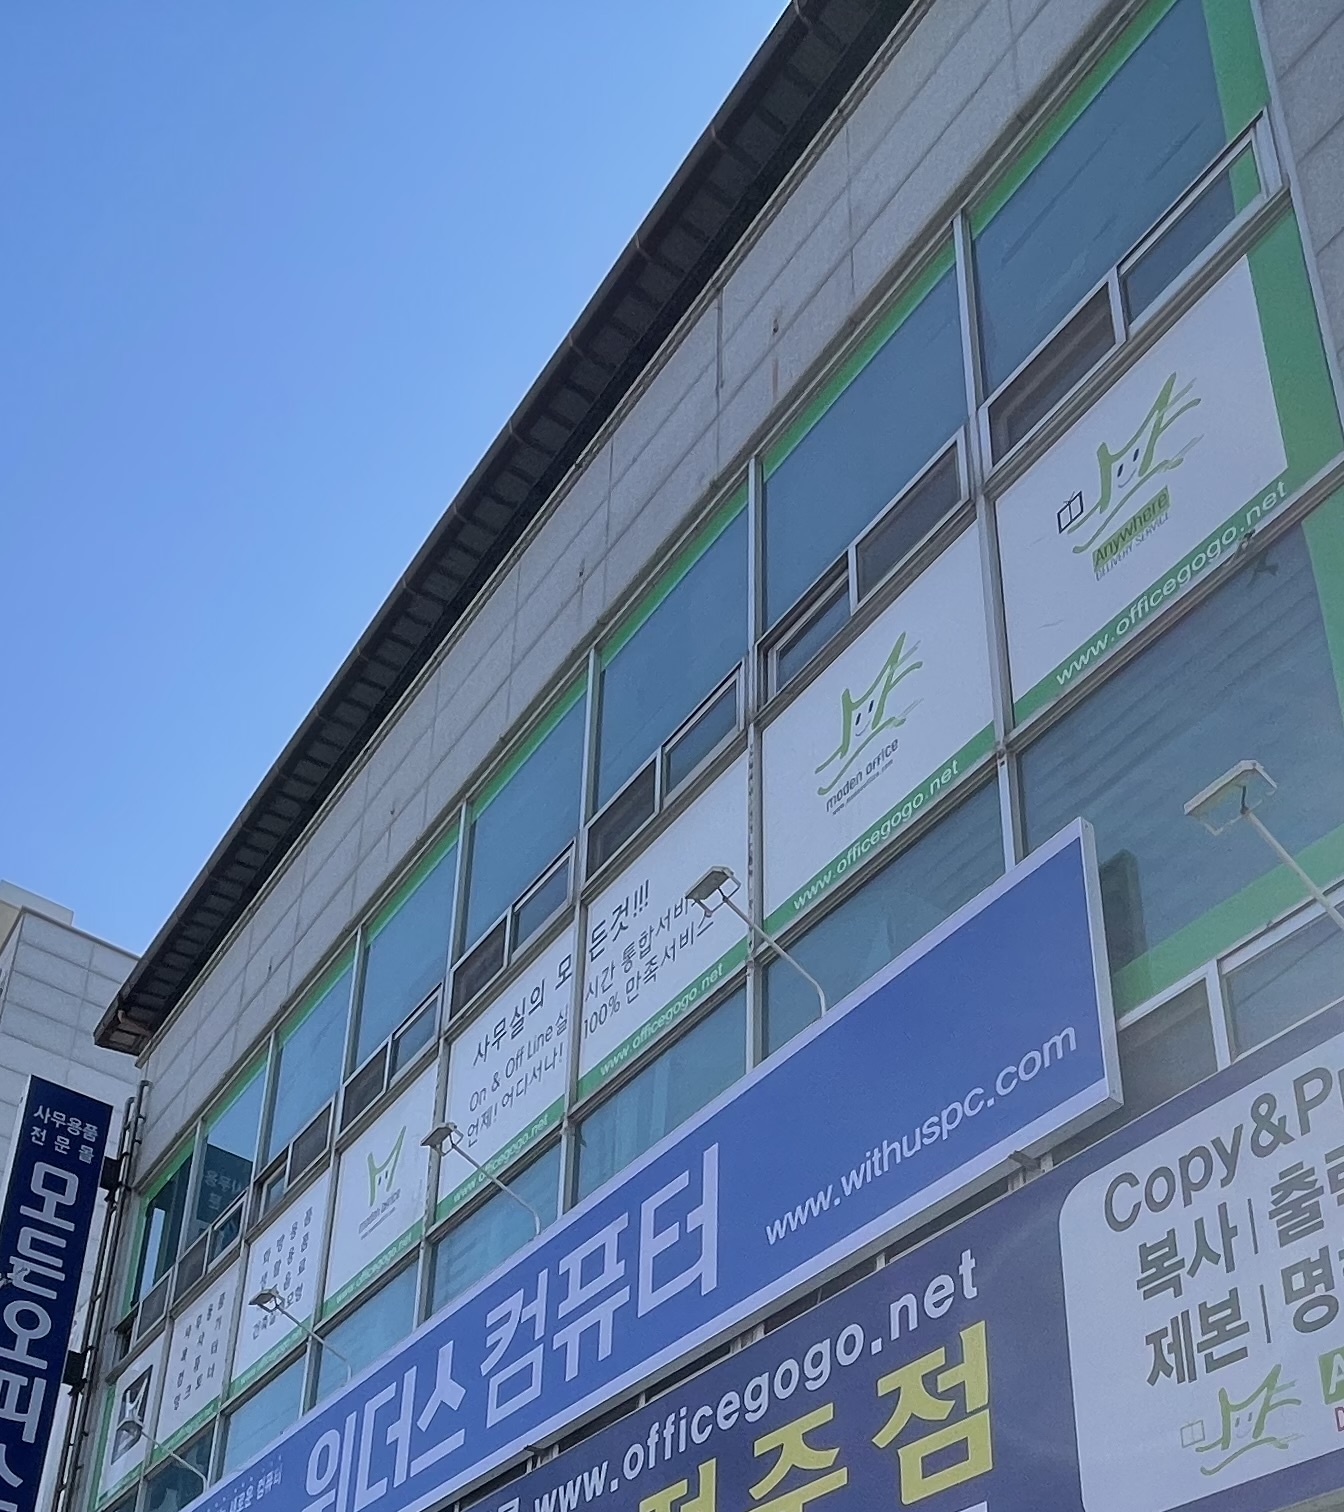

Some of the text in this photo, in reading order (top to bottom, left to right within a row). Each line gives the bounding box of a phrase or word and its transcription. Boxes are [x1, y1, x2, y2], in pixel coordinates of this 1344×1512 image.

[1095, 492, 1168, 567] Anywhere
[1055, 479, 1289, 688] www.officegogo.net
[825, 770, 863, 813] moden
[865, 738, 898, 776] office
[792, 760, 960, 911] www.officegogo.net
[472, 978, 546, 1067] 사무실의
[583, 993, 622, 1040] 100%
[599, 962, 725, 1078] www.officegogo.net
[32, 1102, 100, 1143] 사무용품
[468, 1086, 488, 1113] On
[490, 1071, 502, 1093] &
[765, 1026, 1078, 1246] www.withuspc.com
[1135, 1199, 1239, 1302] 복사
[1144, 1290, 1251, 1388] 제본
